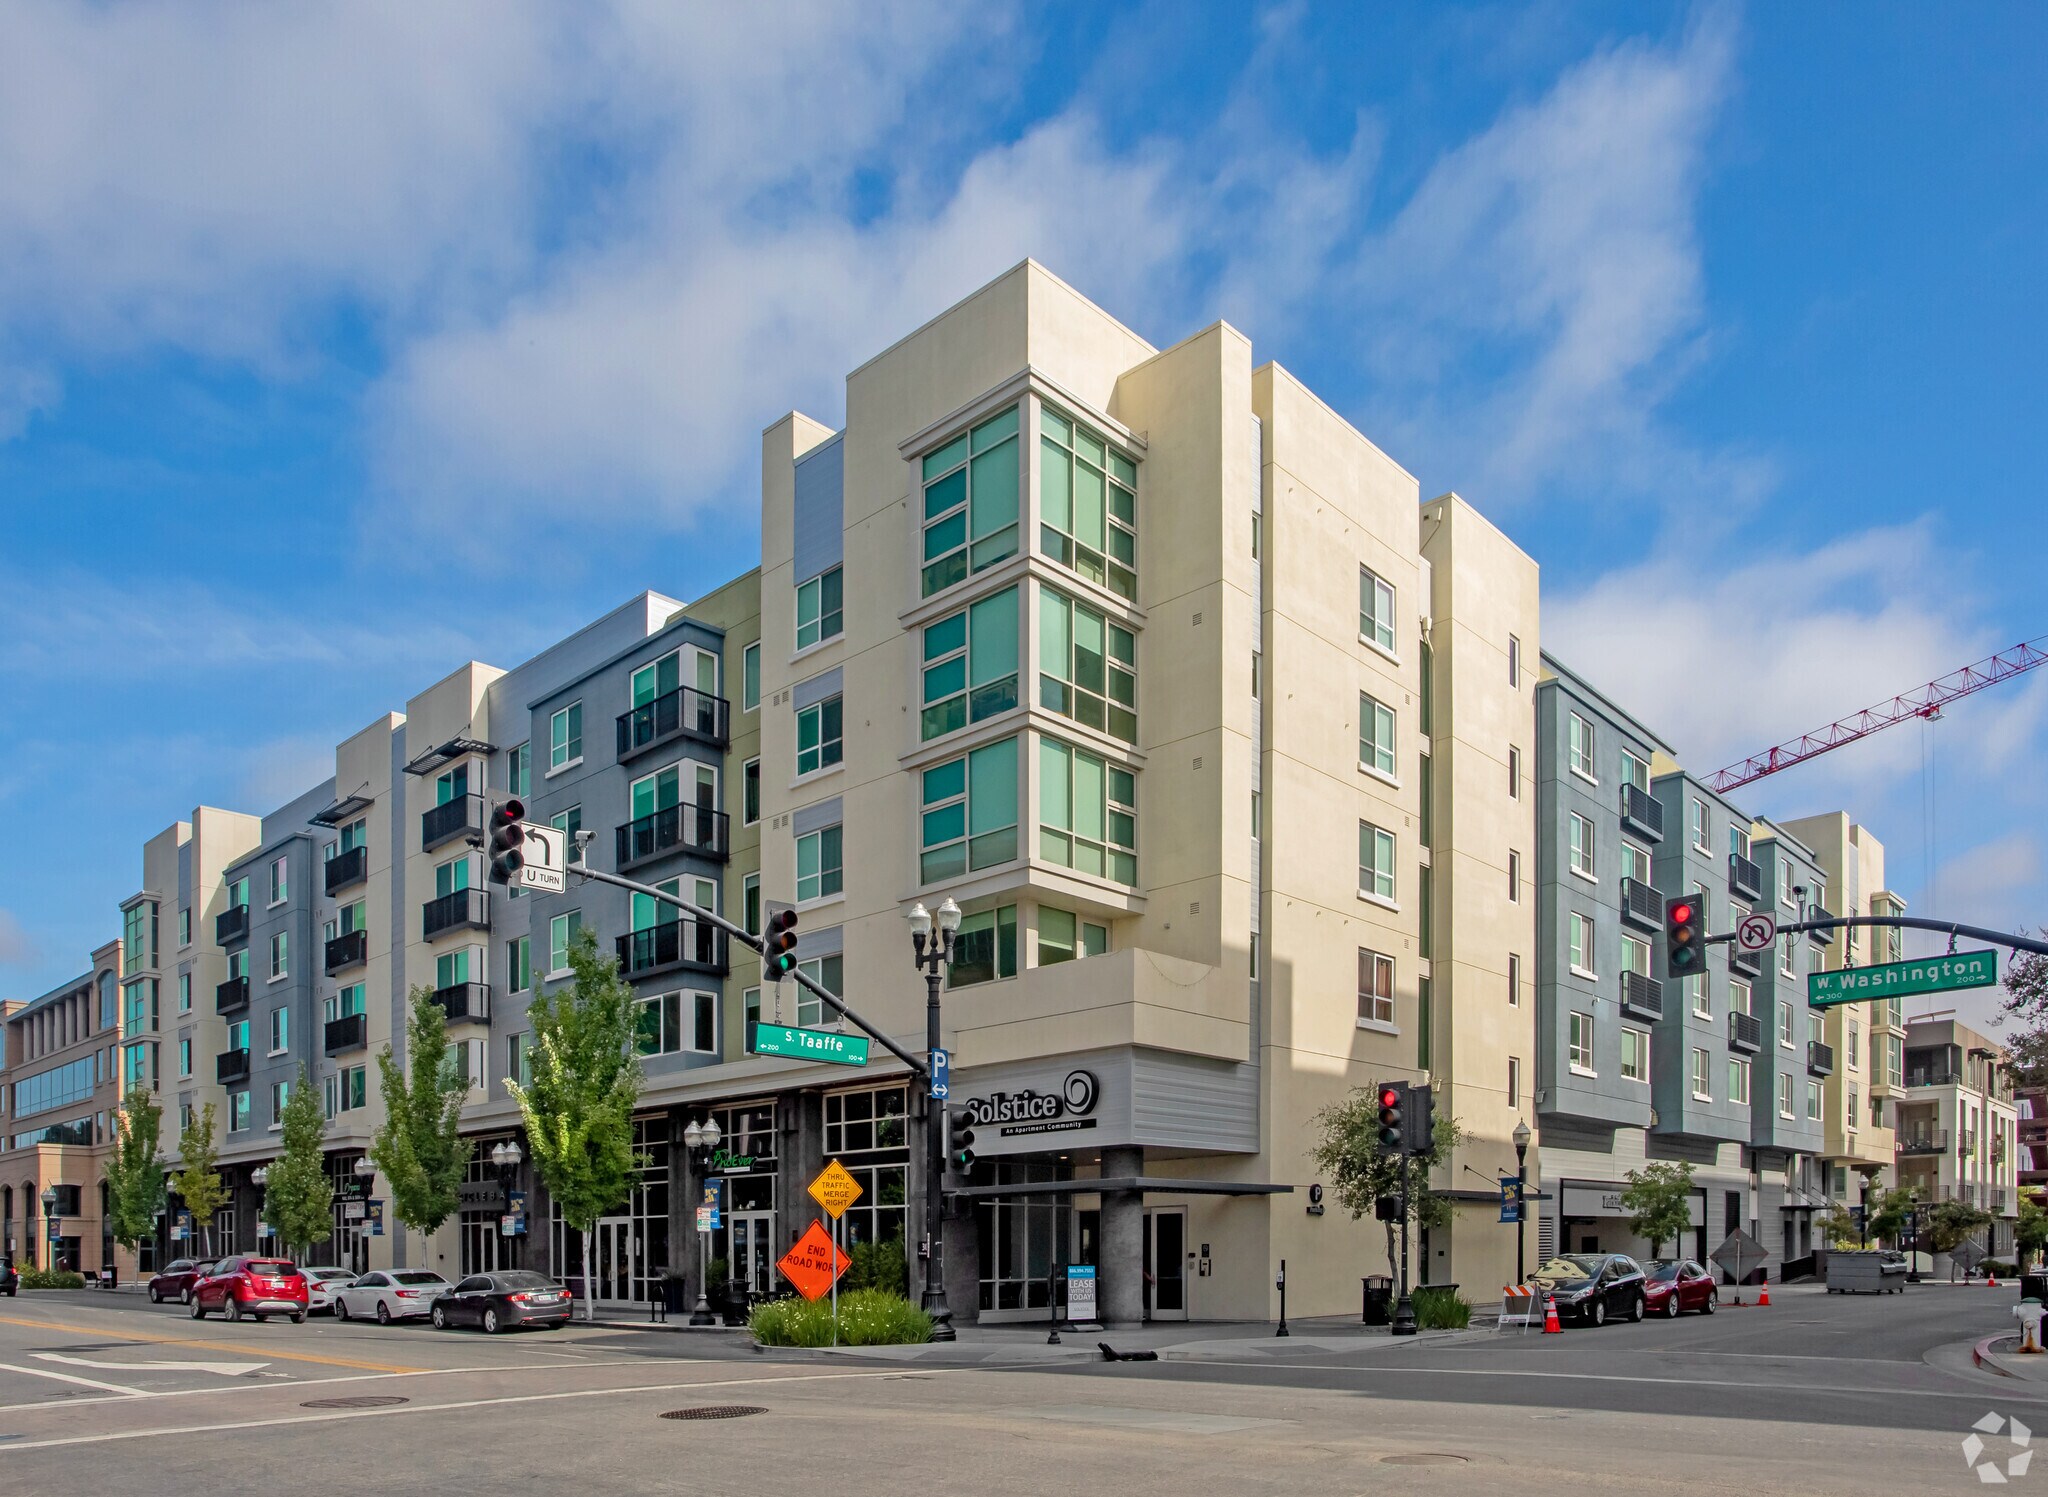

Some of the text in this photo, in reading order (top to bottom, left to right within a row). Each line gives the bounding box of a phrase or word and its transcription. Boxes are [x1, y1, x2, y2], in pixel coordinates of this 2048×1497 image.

[527, 869, 536, 882] U
[540, 873, 560, 885] TURN
[1817, 960, 1983, 990] W. Washington
[1956, 976, 1975, 984] 200
[1826, 992, 1843, 1000] 300
[785, 1031, 843, 1051] S. Taaffe
[934, 1051, 947, 1078] P
[965, 1091, 1058, 1124] Solstice
[1015, 1125, 1046, 1134] Apartment
[1047, 1121, 1082, 1130] Community
[827, 1173, 845, 1181] THRU
[807, 1244, 826, 1257] END
[786, 1254, 813, 1268] ROAD
[1069, 1280, 1093, 1288] LEASE
